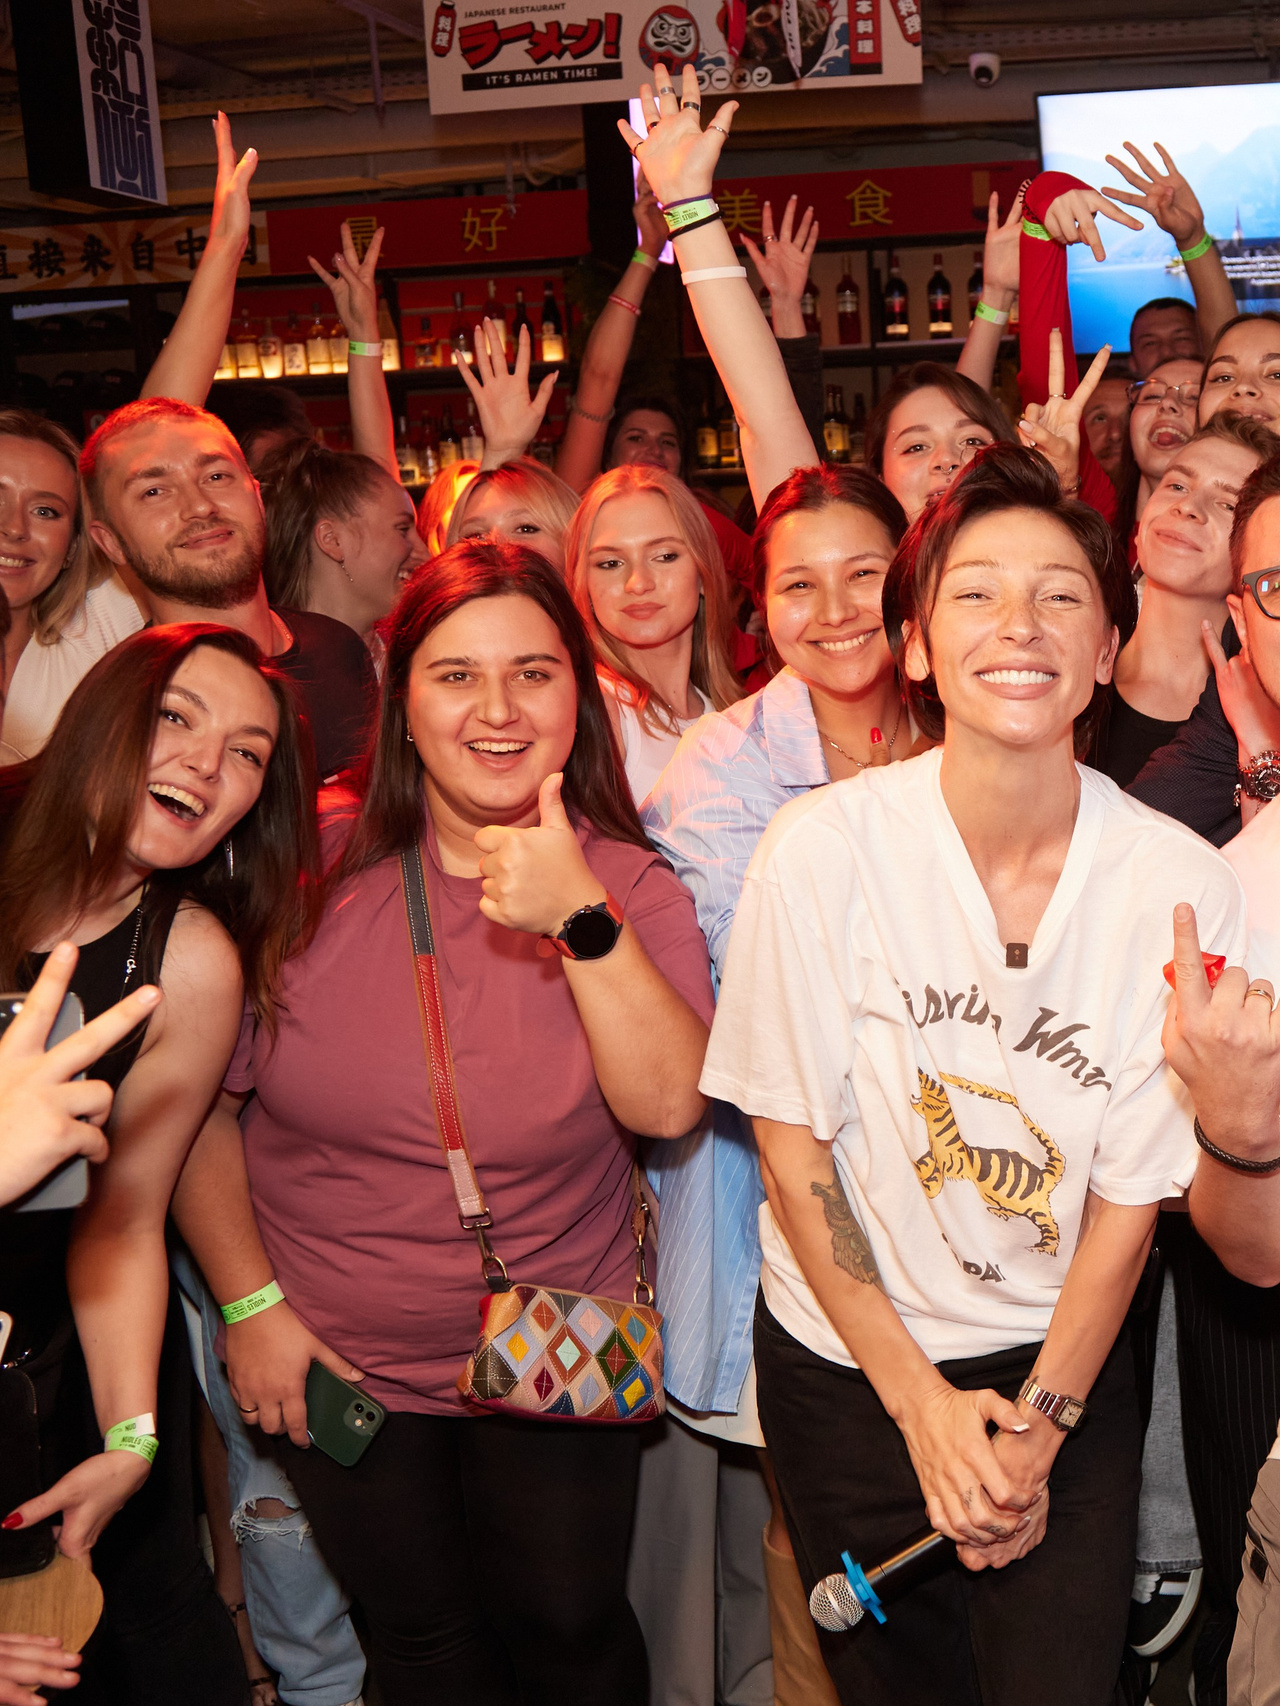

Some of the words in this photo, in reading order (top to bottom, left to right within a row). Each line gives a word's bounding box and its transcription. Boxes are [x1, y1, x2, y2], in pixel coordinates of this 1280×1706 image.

[464, 8, 506, 19] JAPANESE
[509, 3, 566, 15] RESTAURANT
[486, 75, 511, 86] IT'S
[515, 71, 558, 83] RAMEN
[564, 68, 598, 80] TIME!
